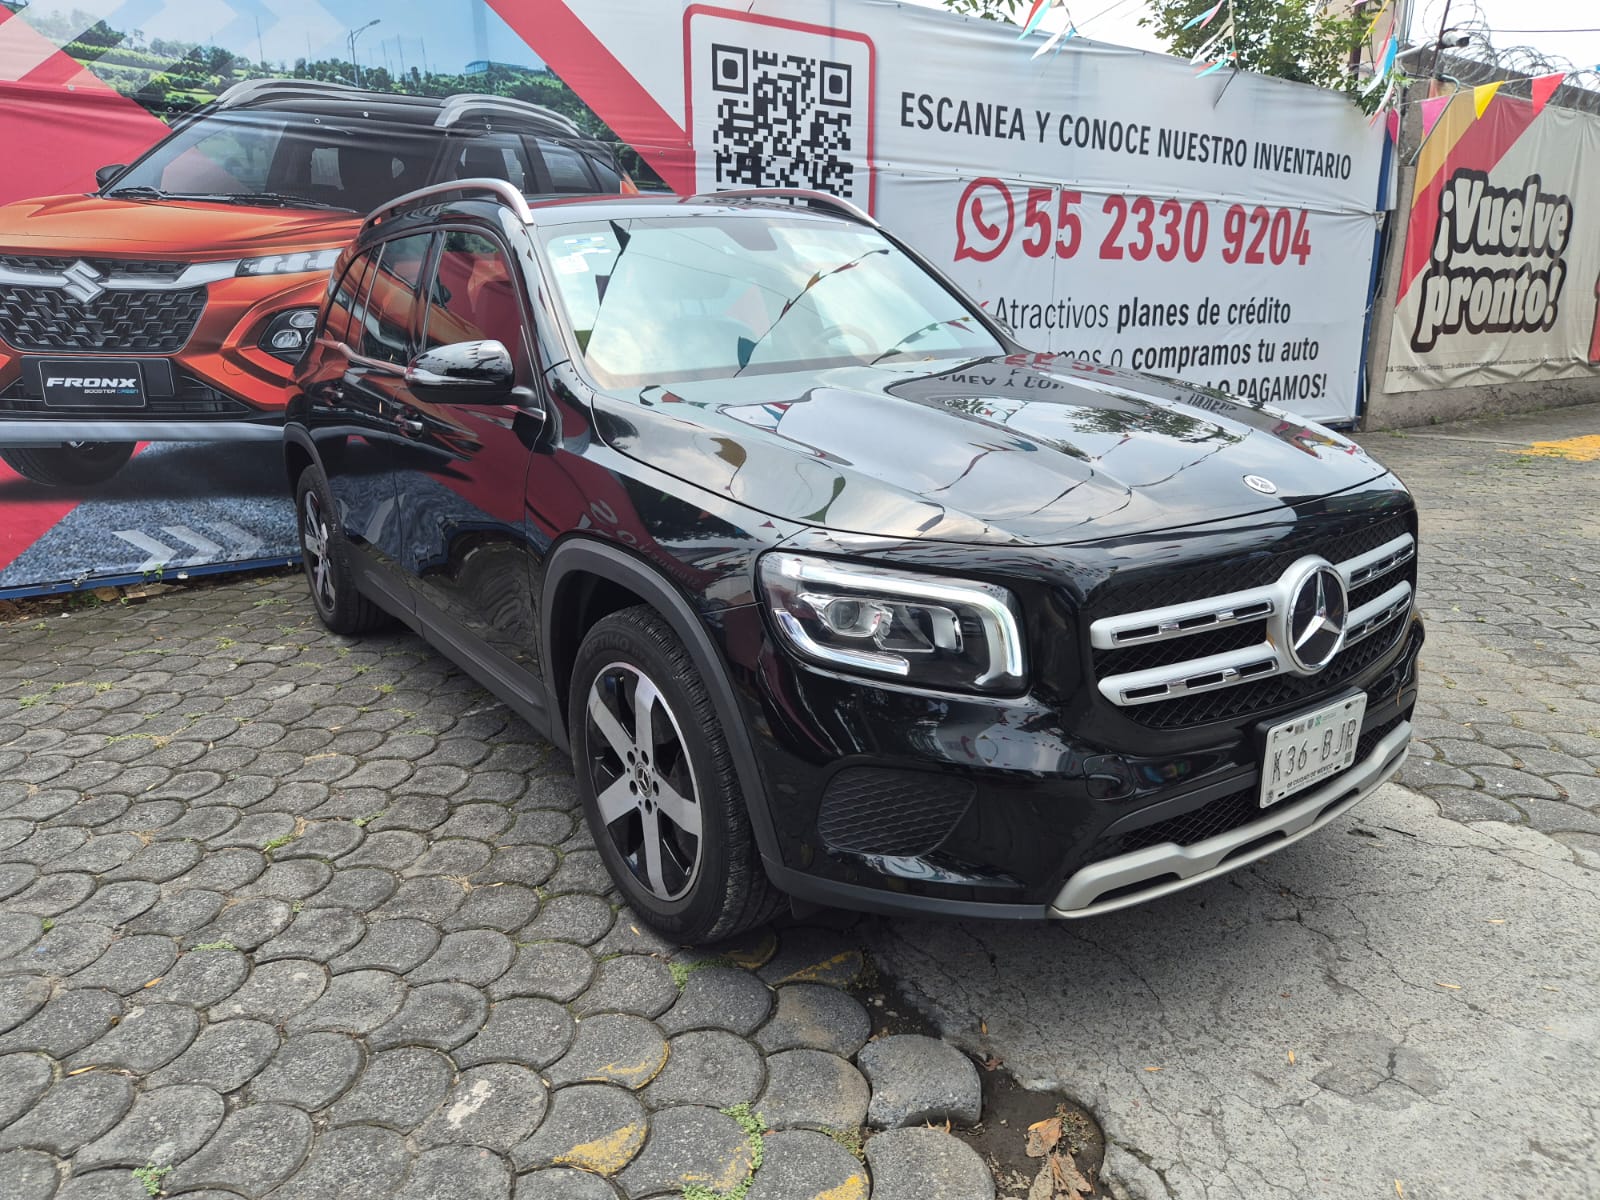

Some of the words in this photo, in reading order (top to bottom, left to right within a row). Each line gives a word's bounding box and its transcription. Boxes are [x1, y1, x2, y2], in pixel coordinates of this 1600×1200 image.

[900, 91, 1026, 141] ESCANEA
[1036, 111, 1051, 143] Y
[1058, 114, 1151, 156] CONOCE
[1157, 128, 1248, 168] NUESTRO
[1253, 142, 1352, 181] INVENTARIO
[1022, 188, 1082, 260] 55
[1099, 194, 1208, 263] 2330
[1221, 203, 1312, 266] 9204
[1433, 171, 1572, 263] ¡Vuelve
[995, 297, 1109, 330] Atractivos
[1117, 297, 1190, 334] planes
[1196, 299, 1220, 326] de
[1227, 297, 1291, 325] crédito
[1412, 258, 1565, 350] pronto!
[46, 377, 137, 388] FRONX
[1111, 348, 1123, 368] o
[1132, 342, 1251, 374] compramos
[1258, 338, 1276, 363] tu
[1280, 337, 1319, 362] auto
[1237, 373, 1327, 402] PAGAMOS!
